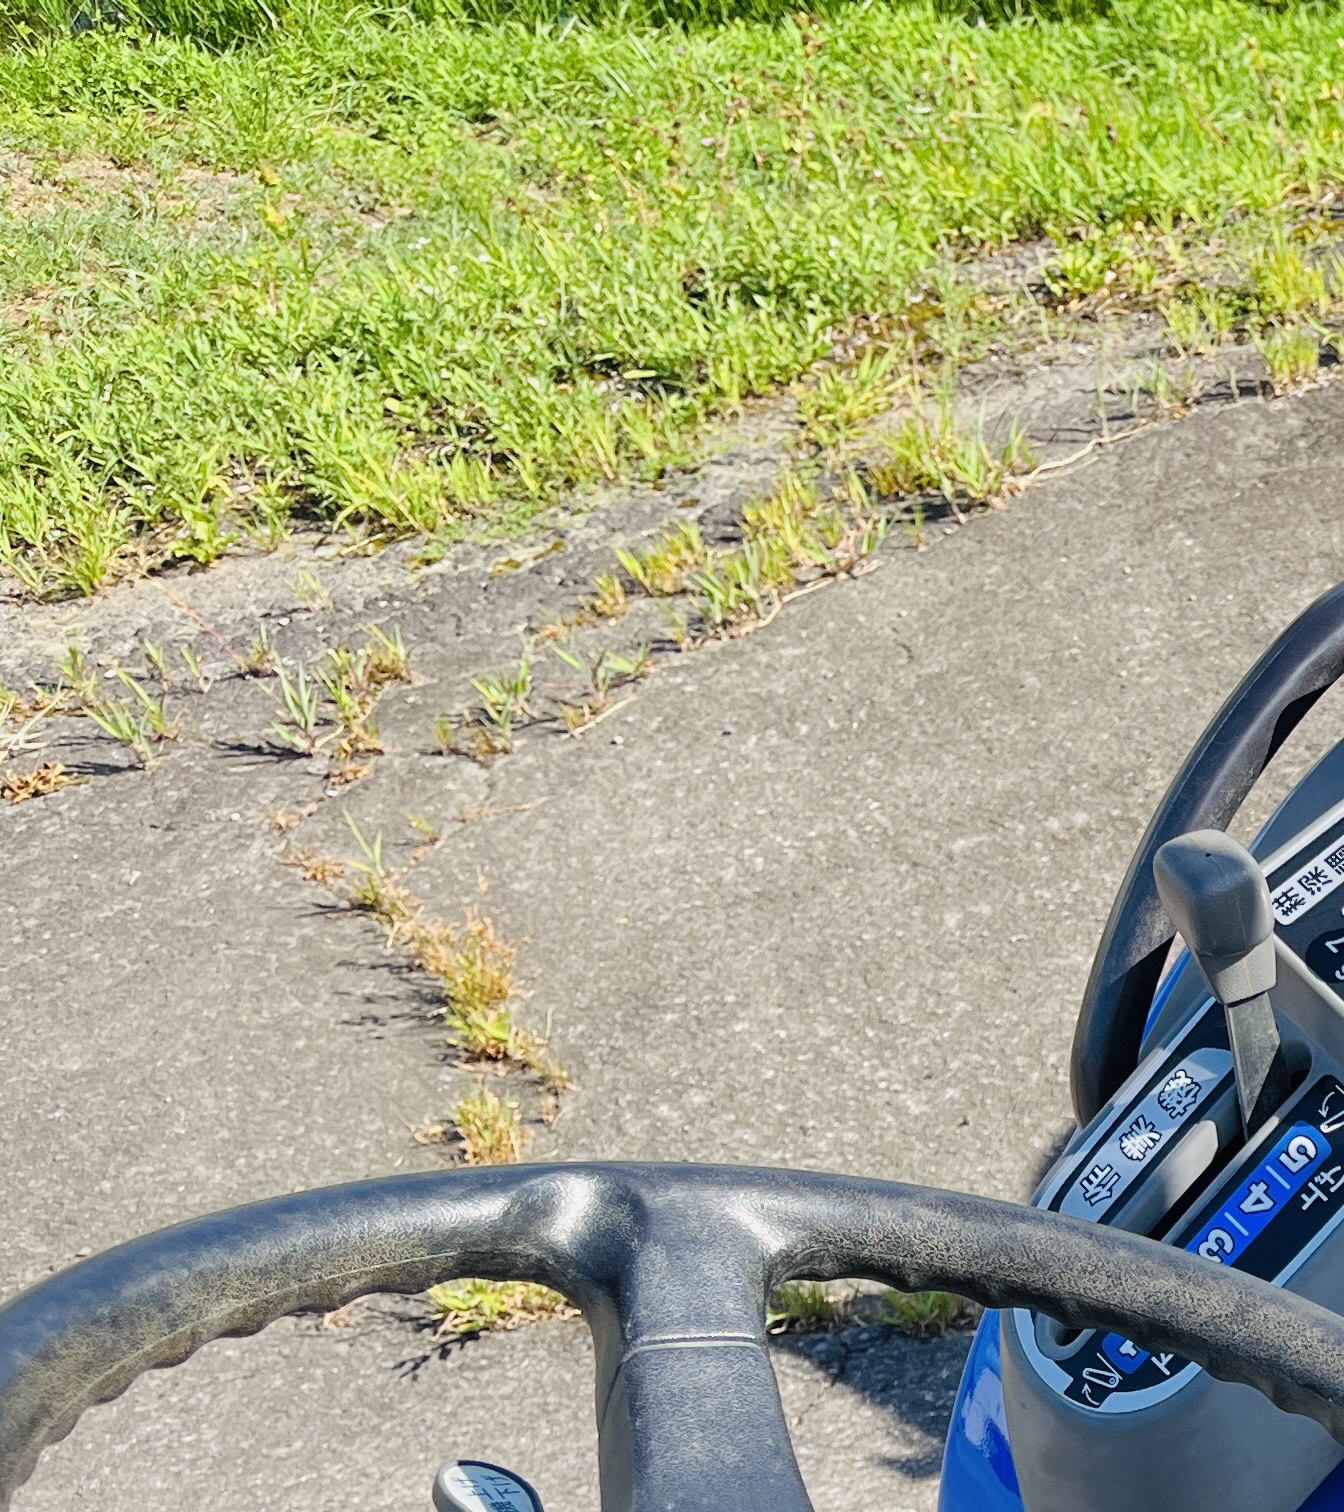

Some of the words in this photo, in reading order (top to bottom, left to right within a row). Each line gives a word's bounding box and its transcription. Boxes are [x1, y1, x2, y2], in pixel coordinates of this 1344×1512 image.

[1080, 1069, 1201, 1206] 作業機
[1277, 1135, 1319, 1174] 5
[1238, 1180, 1275, 1216] 4
[1198, 1227, 1235, 1263] 3
